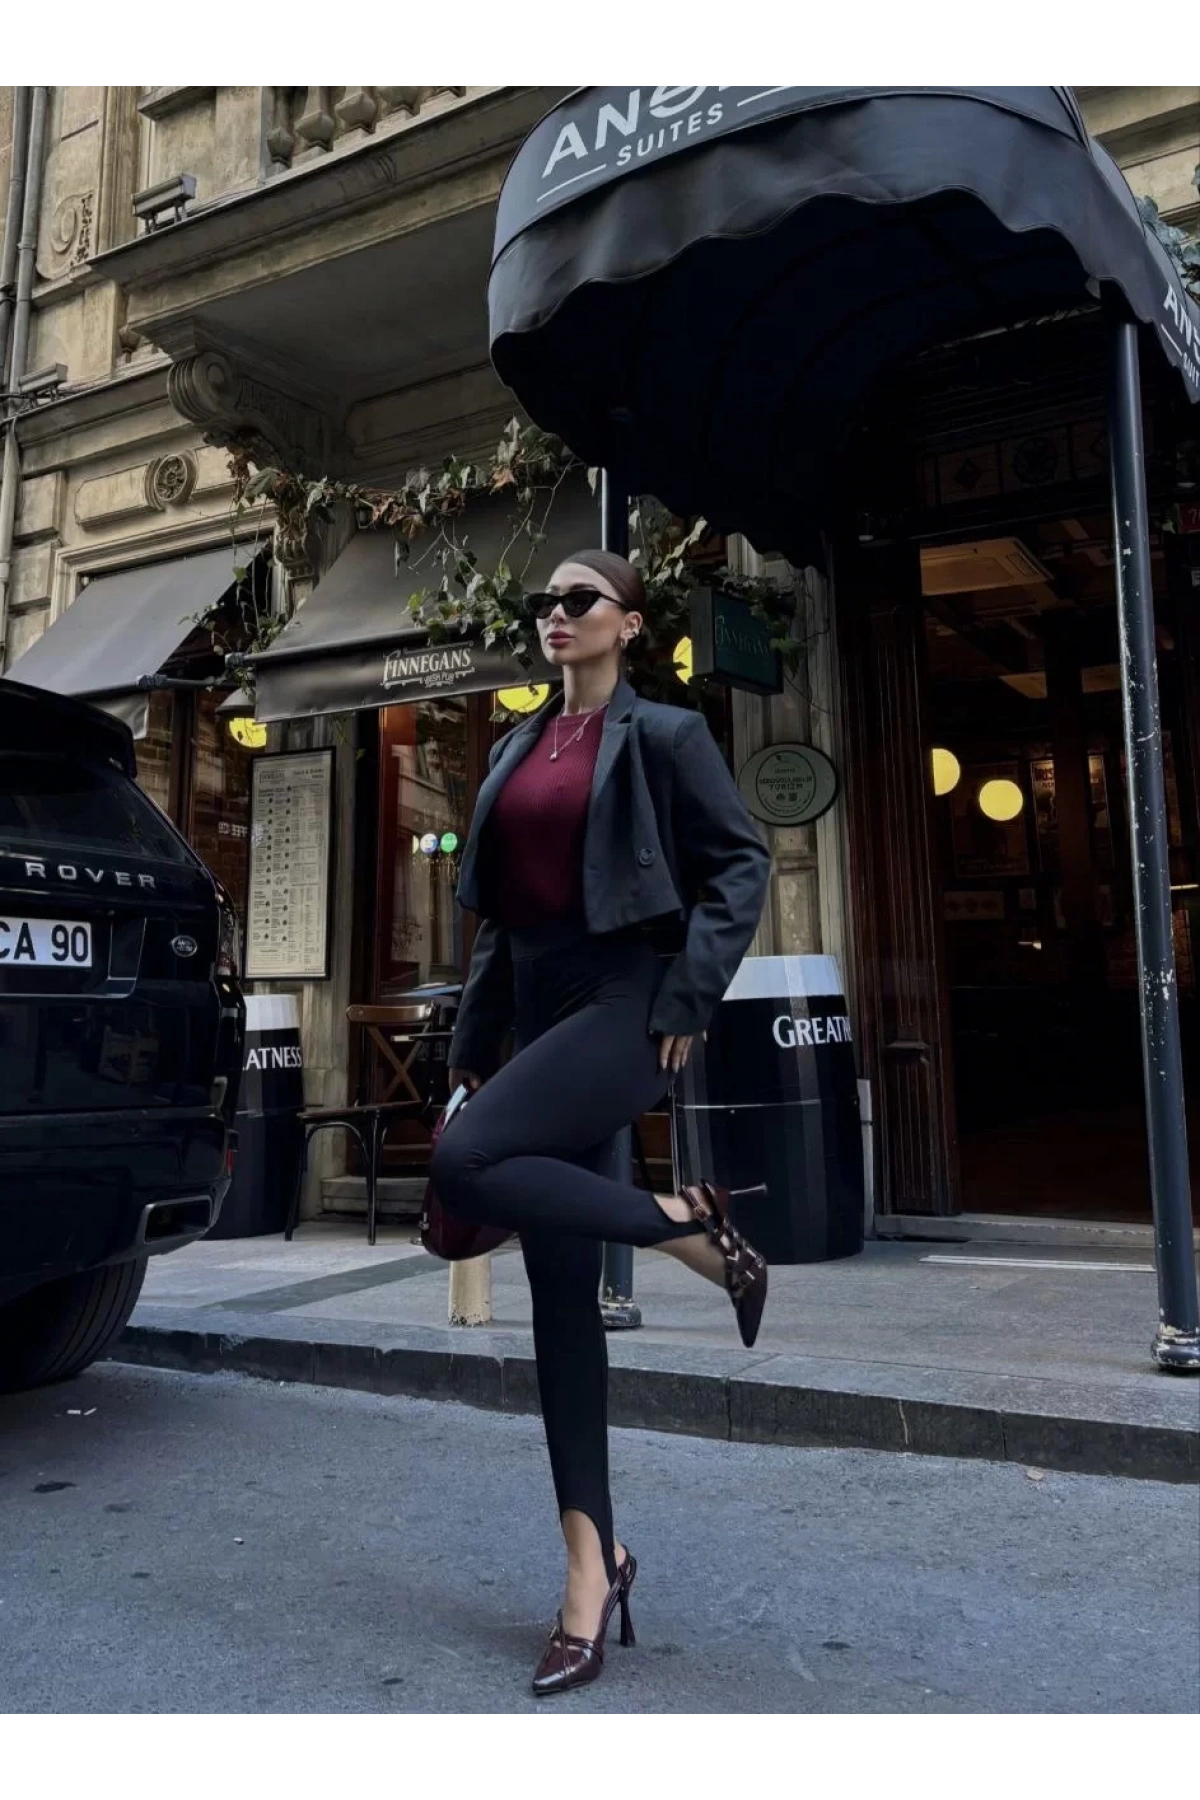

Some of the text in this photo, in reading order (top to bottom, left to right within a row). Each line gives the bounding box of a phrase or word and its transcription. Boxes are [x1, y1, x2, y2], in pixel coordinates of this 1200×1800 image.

[617, 103, 723, 166] SUITES
[383, 648, 471, 684] FINNEGANS
[25, 861, 156, 889] ROVER
[0, 921, 89, 962] CA 90
[242, 1046, 302, 1071] ATNESS
